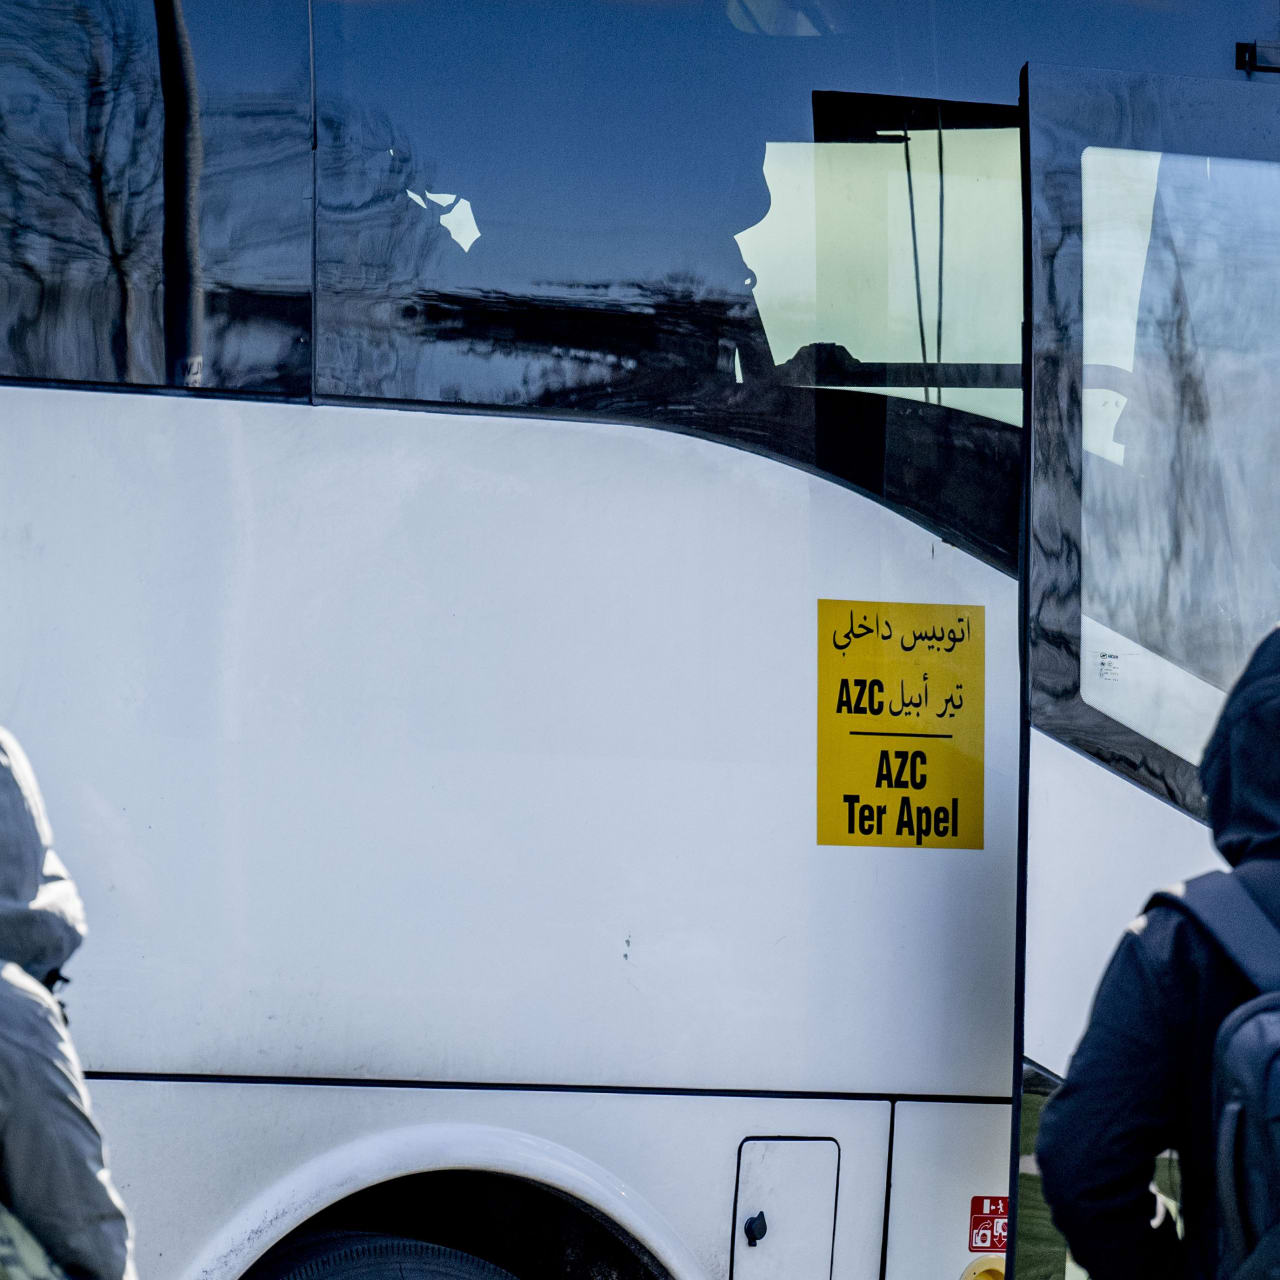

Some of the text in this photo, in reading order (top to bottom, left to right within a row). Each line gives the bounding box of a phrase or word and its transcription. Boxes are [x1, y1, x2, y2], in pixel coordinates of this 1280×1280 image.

[900, 615, 971, 652] اتوبيس
[836, 678, 885, 716] AZC
[936, 684, 964, 718] تير
[875, 750, 927, 790] AZC
[843, 794, 959, 846] Ter Apel
